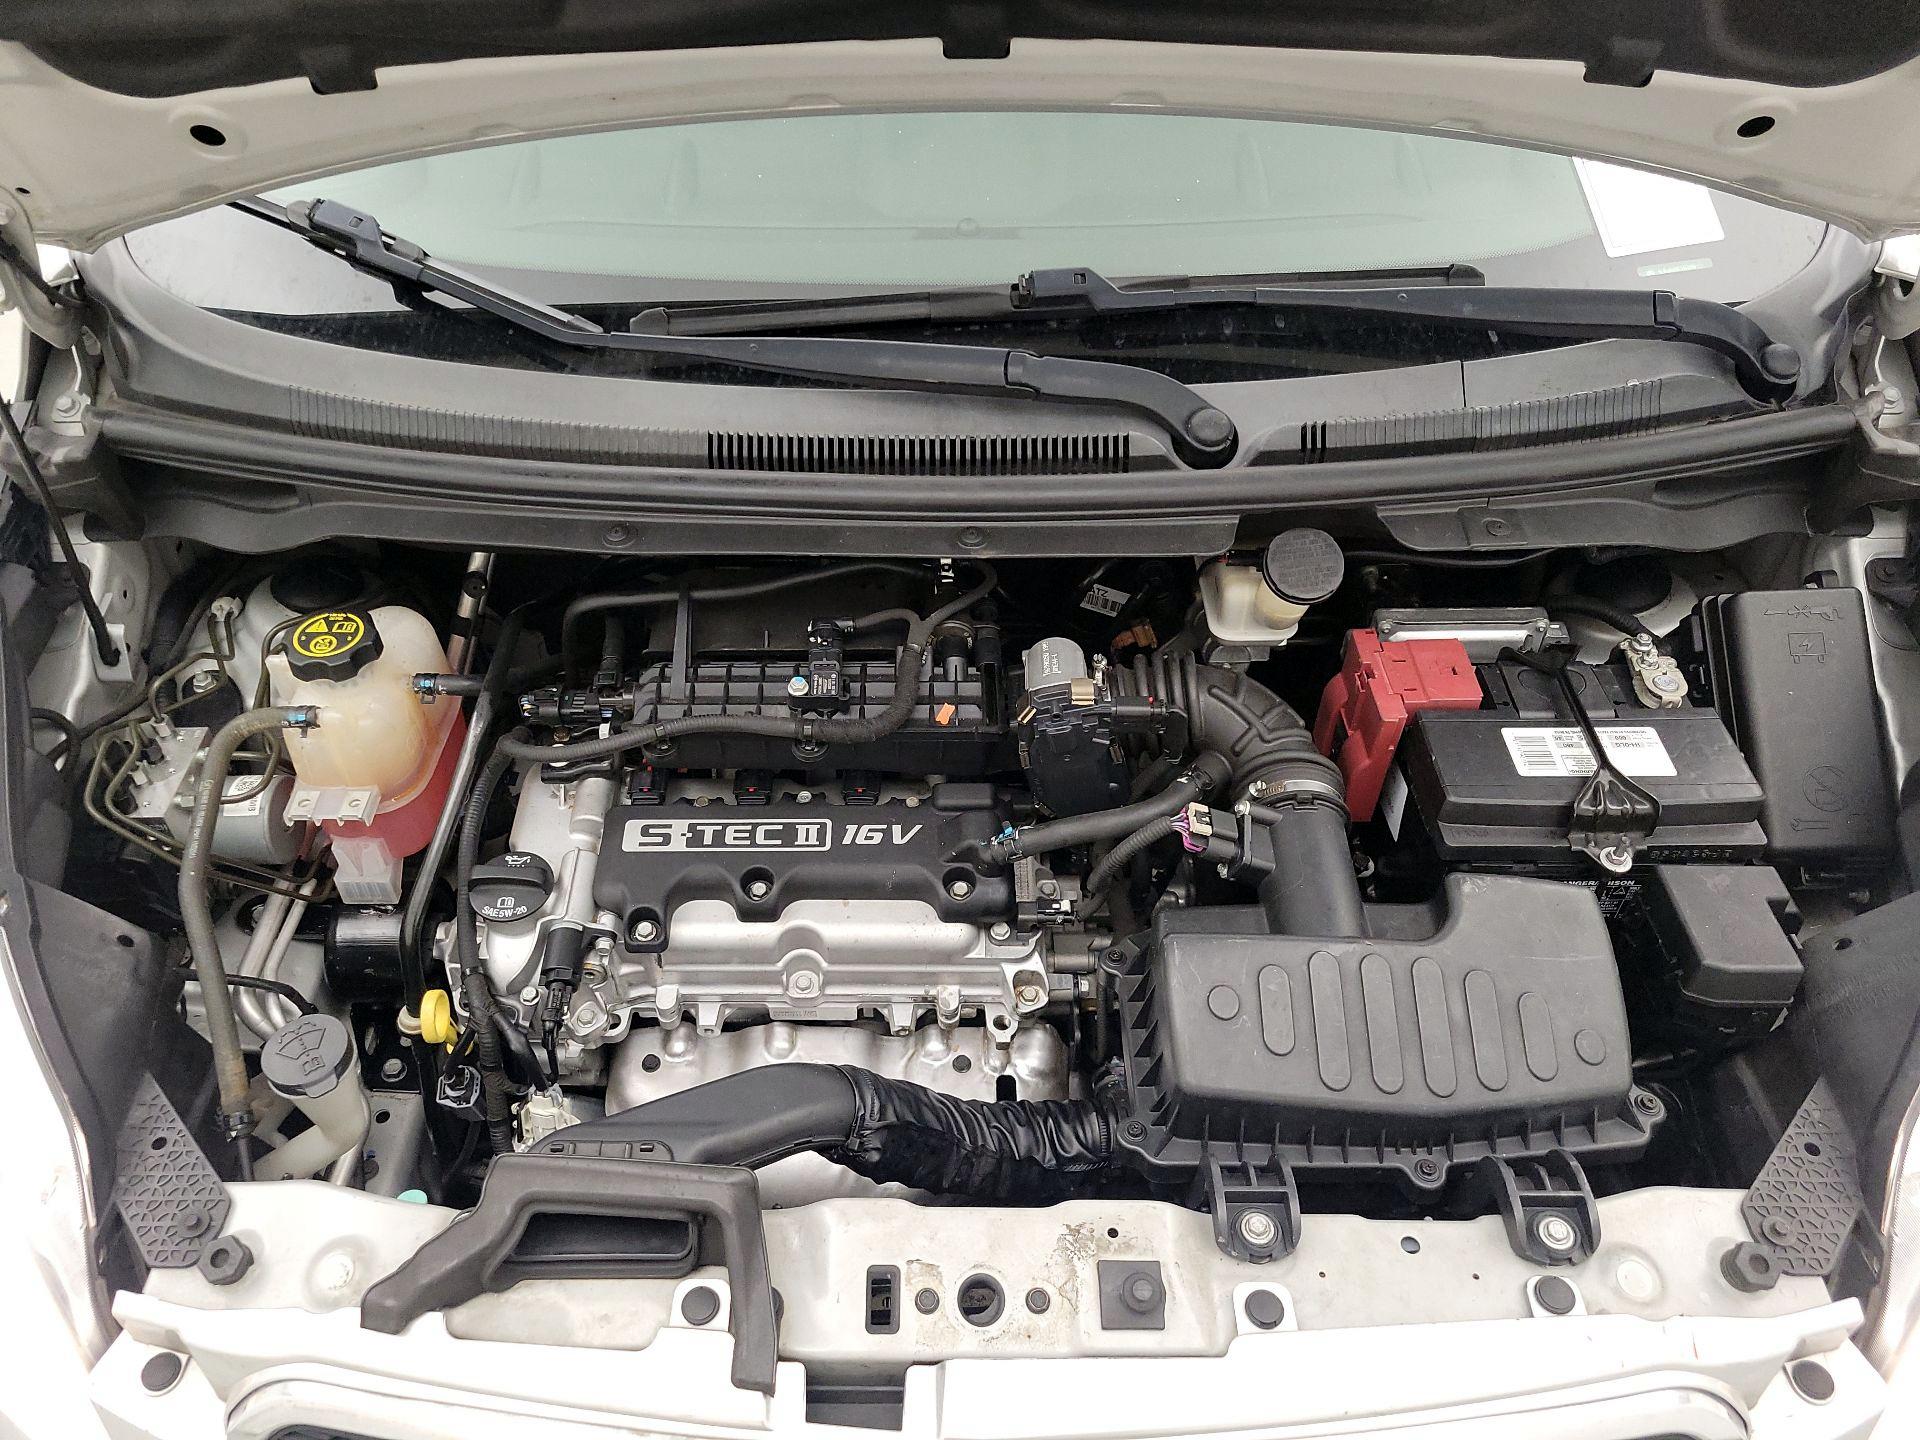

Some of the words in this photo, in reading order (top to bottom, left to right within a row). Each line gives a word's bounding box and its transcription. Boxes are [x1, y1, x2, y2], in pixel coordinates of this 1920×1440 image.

[638, 823, 784, 848] S-TEC
[794, 824, 821, 846] II
[842, 824, 923, 846] 16V
